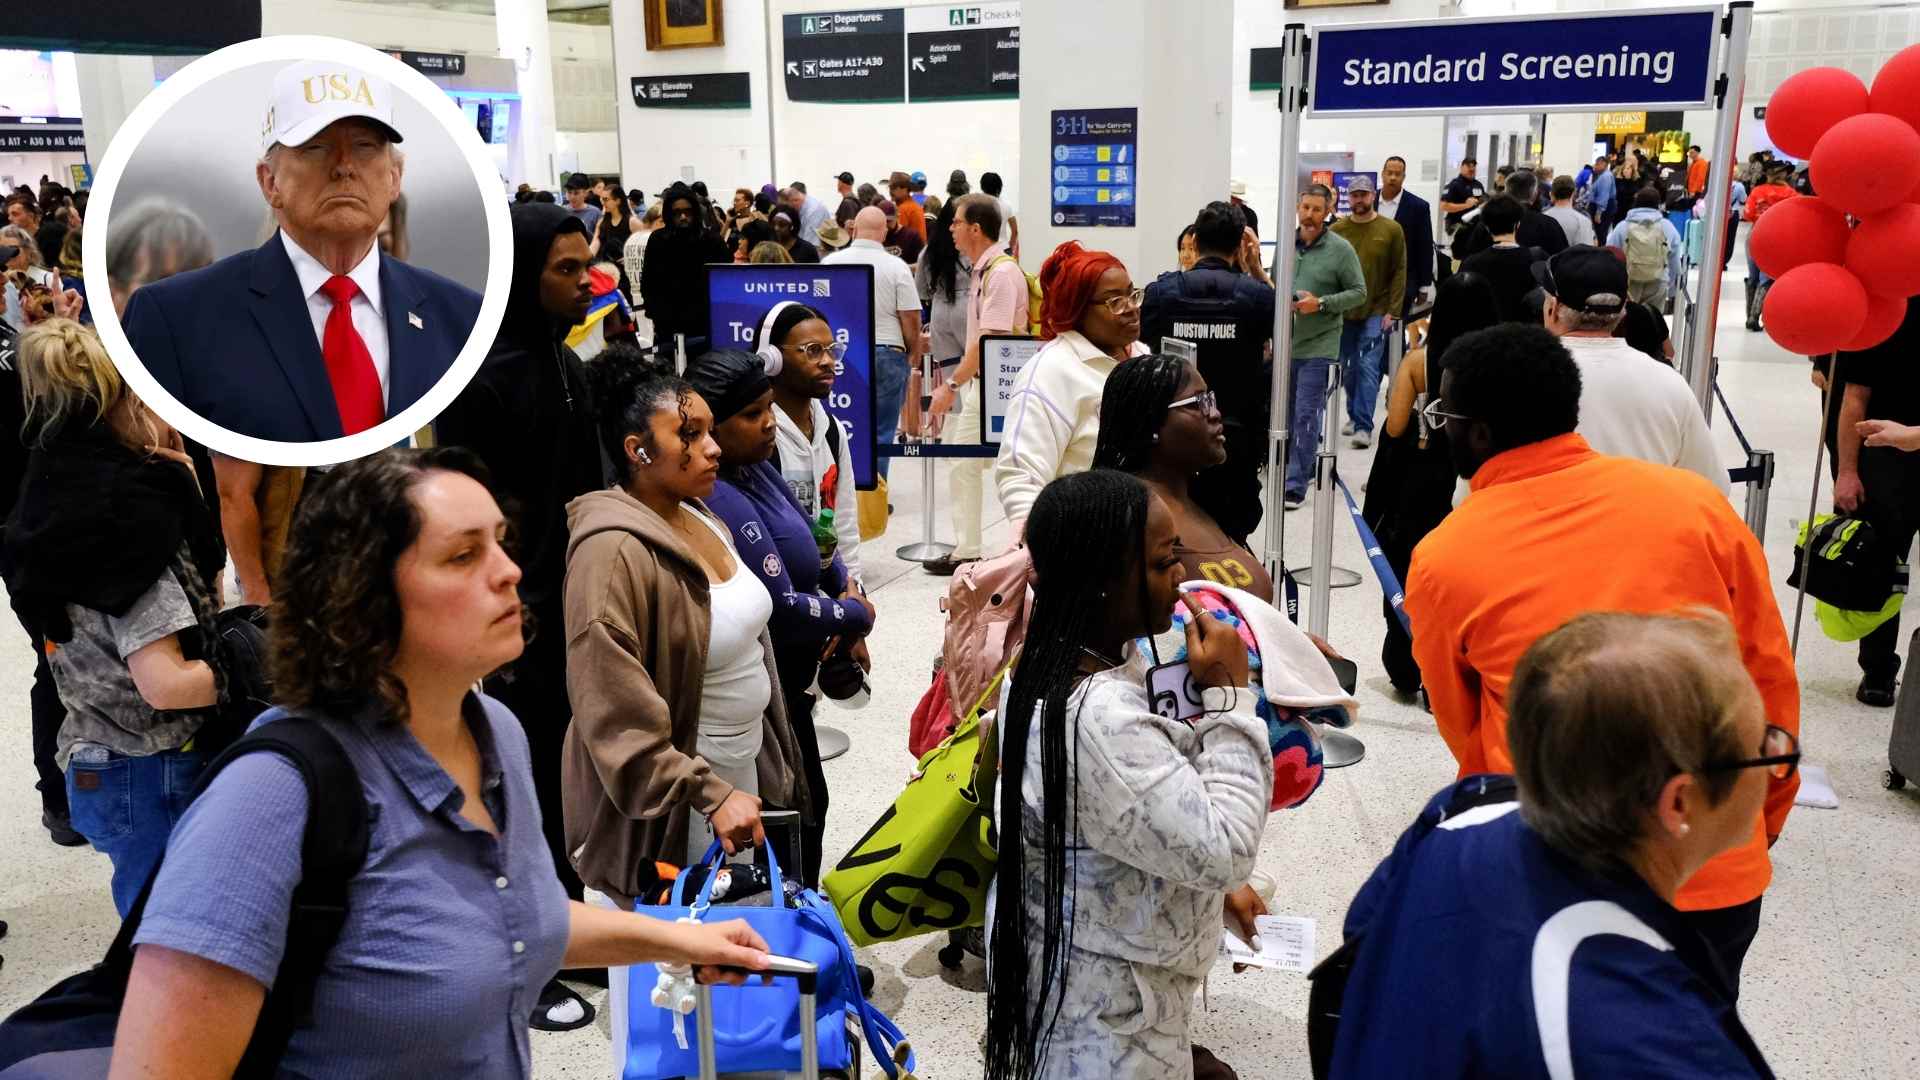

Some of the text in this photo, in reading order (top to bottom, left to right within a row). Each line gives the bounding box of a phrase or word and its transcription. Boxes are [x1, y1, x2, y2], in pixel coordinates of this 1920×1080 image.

[929, 44, 961, 52] American
[819, 57, 883, 68] Gates A17-A30
[929, 54, 947, 64] Spirit
[1343, 45, 1675, 85] Standard Screening
[303, 72, 375, 107] USA
[662, 83, 693, 91] Elevators
[30, 136, 44, 146] A30
[744, 282, 809, 293] UNITED
[1173, 322, 1236, 339] HOUSTON POLICE
[829, 390, 852, 408] to
[904, 445, 920, 456] IAH
